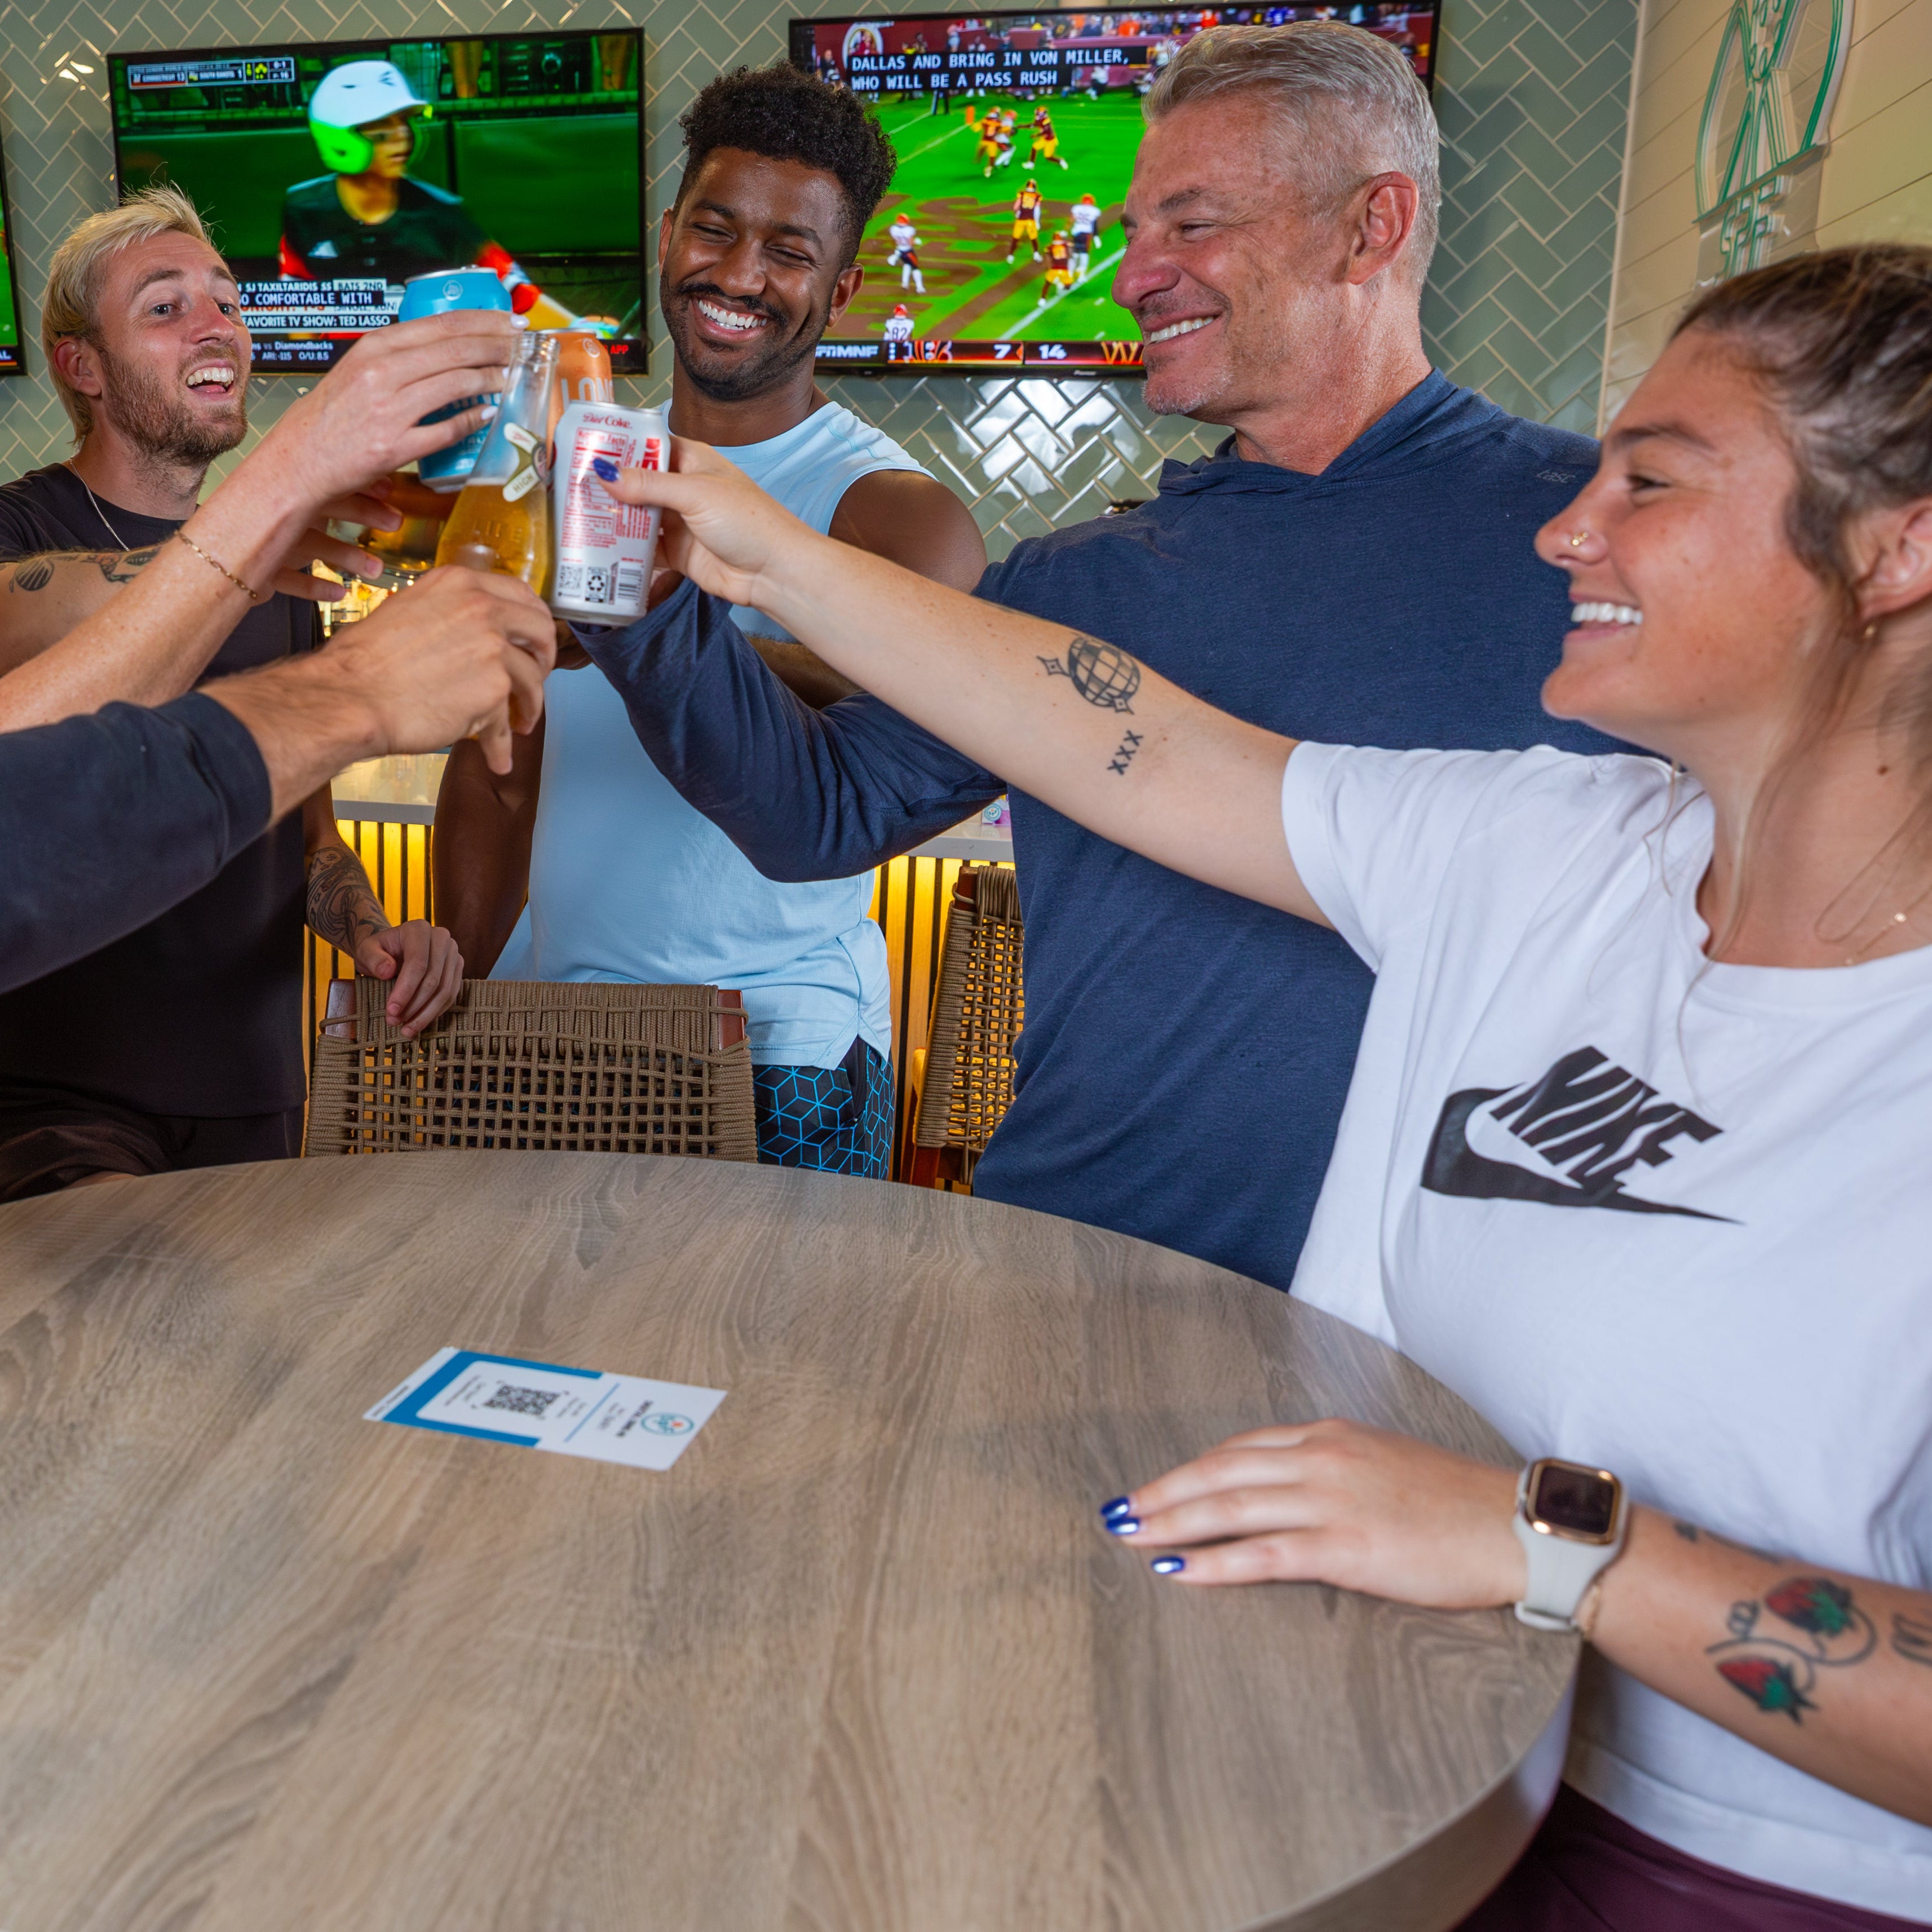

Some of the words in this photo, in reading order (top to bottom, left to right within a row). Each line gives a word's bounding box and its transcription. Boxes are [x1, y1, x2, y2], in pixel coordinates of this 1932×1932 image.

[851, 55, 905, 71] DALLAS
[913, 54, 940, 69] AND
[949, 53, 994, 68] BRING
[1004, 52, 1022, 66] IN
[1031, 51, 1058, 65] VON
[1066, 48, 1129, 65] MILLER,
[851, 76, 879, 90] WHO
[887, 74, 922, 89] WILL
[931, 73, 949, 87] BE
[957, 73, 967, 86] A
[975, 72, 1011, 86] PASS
[1020, 70, 1057, 85] RUSH
[255, 293, 336, 306] COMFORTABLE
[341, 292, 373, 305] WITH
[288, 316, 300, 326] TV
[302, 315, 337, 327] SHOW:
[339, 315, 357, 326] TED
[359, 315, 391, 326] LASSO
[274, 341, 334, 351] Diamondbacks
[610, 344, 629, 354] APP
[837, 345, 879, 359] MNF
[993, 344, 1012, 360] 7
[1038, 344, 1067, 360] 14
[560, 377, 615, 412] LON
[604, 415, 631, 429] Coke
[1488, 1045, 1725, 1195] NIKE
